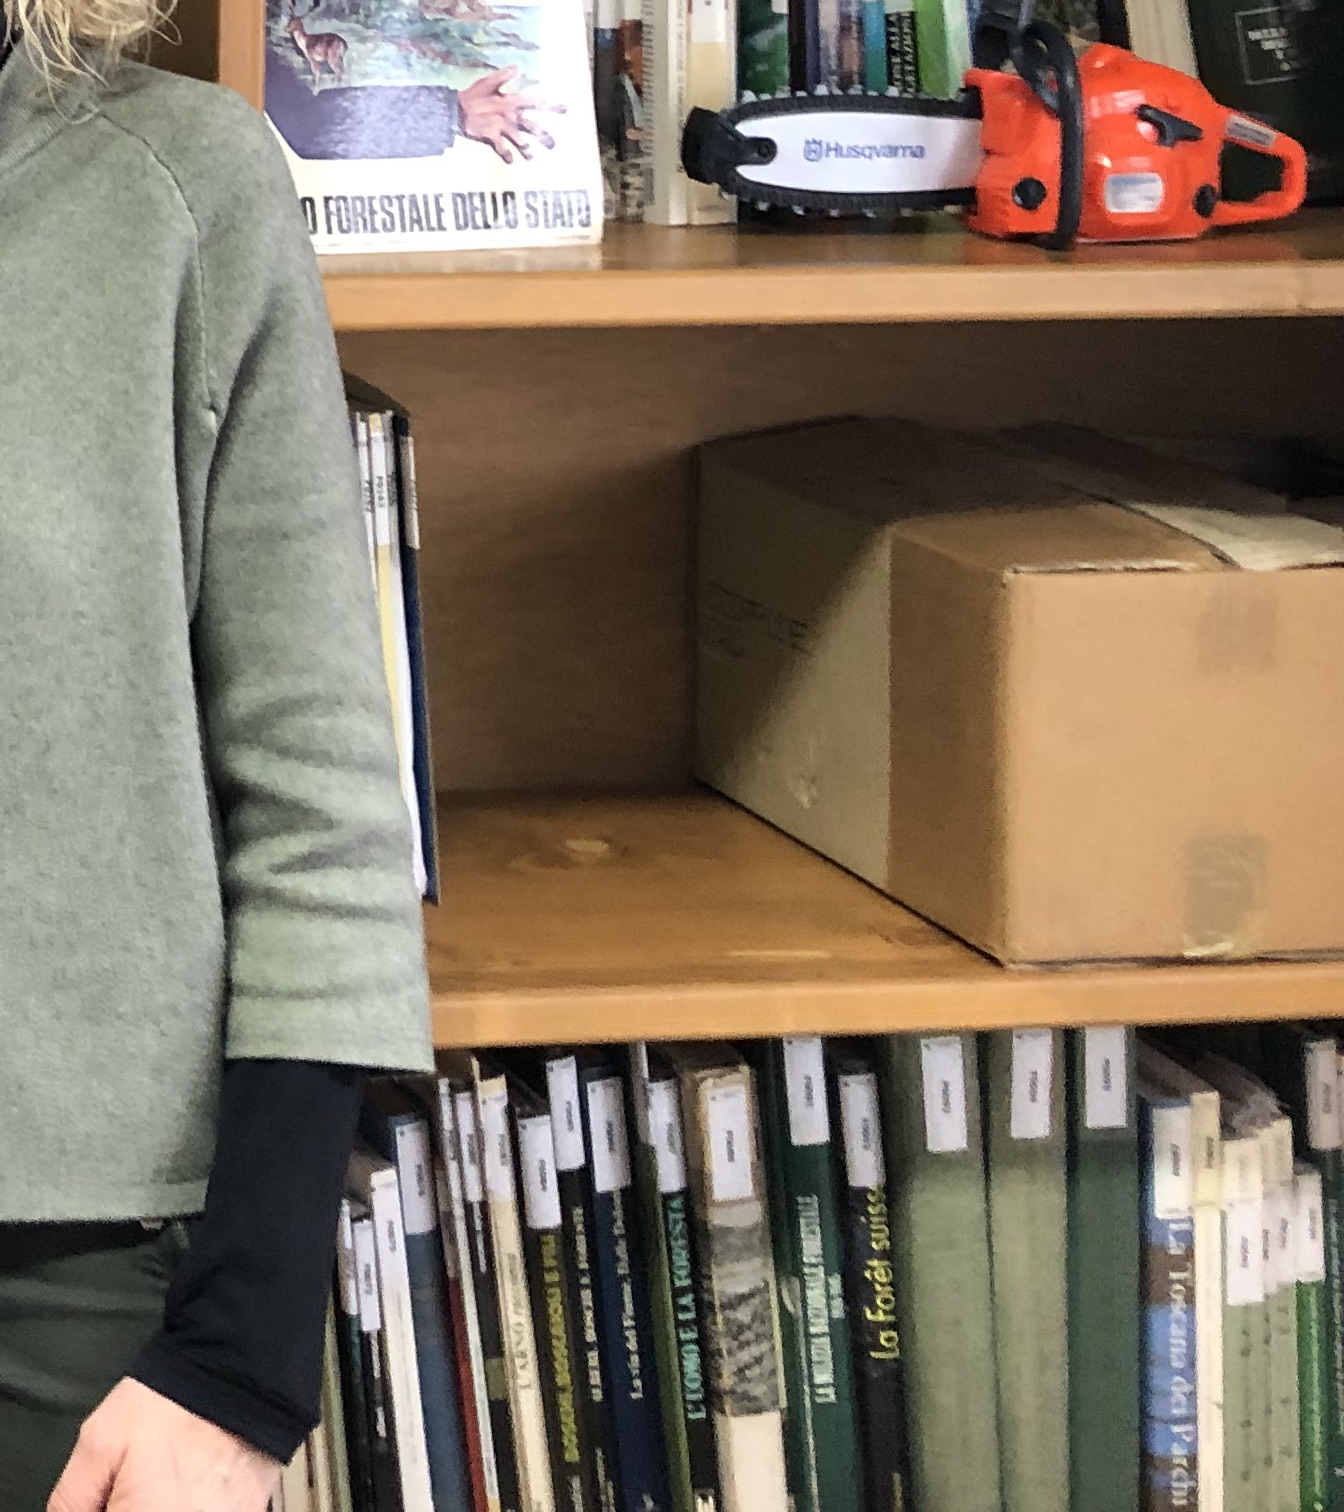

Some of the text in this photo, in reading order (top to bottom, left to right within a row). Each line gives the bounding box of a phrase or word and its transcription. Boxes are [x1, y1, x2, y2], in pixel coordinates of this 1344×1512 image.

[825, 140, 926, 161] Husqvarna
[323, 188, 592, 235] FORESTALE DELLO STATO
[863, 1258, 896, 1322] Forêt
[1168, 1261, 1193, 1369] Toscana
[1170, 1422, 1195, 1507] Parchi
